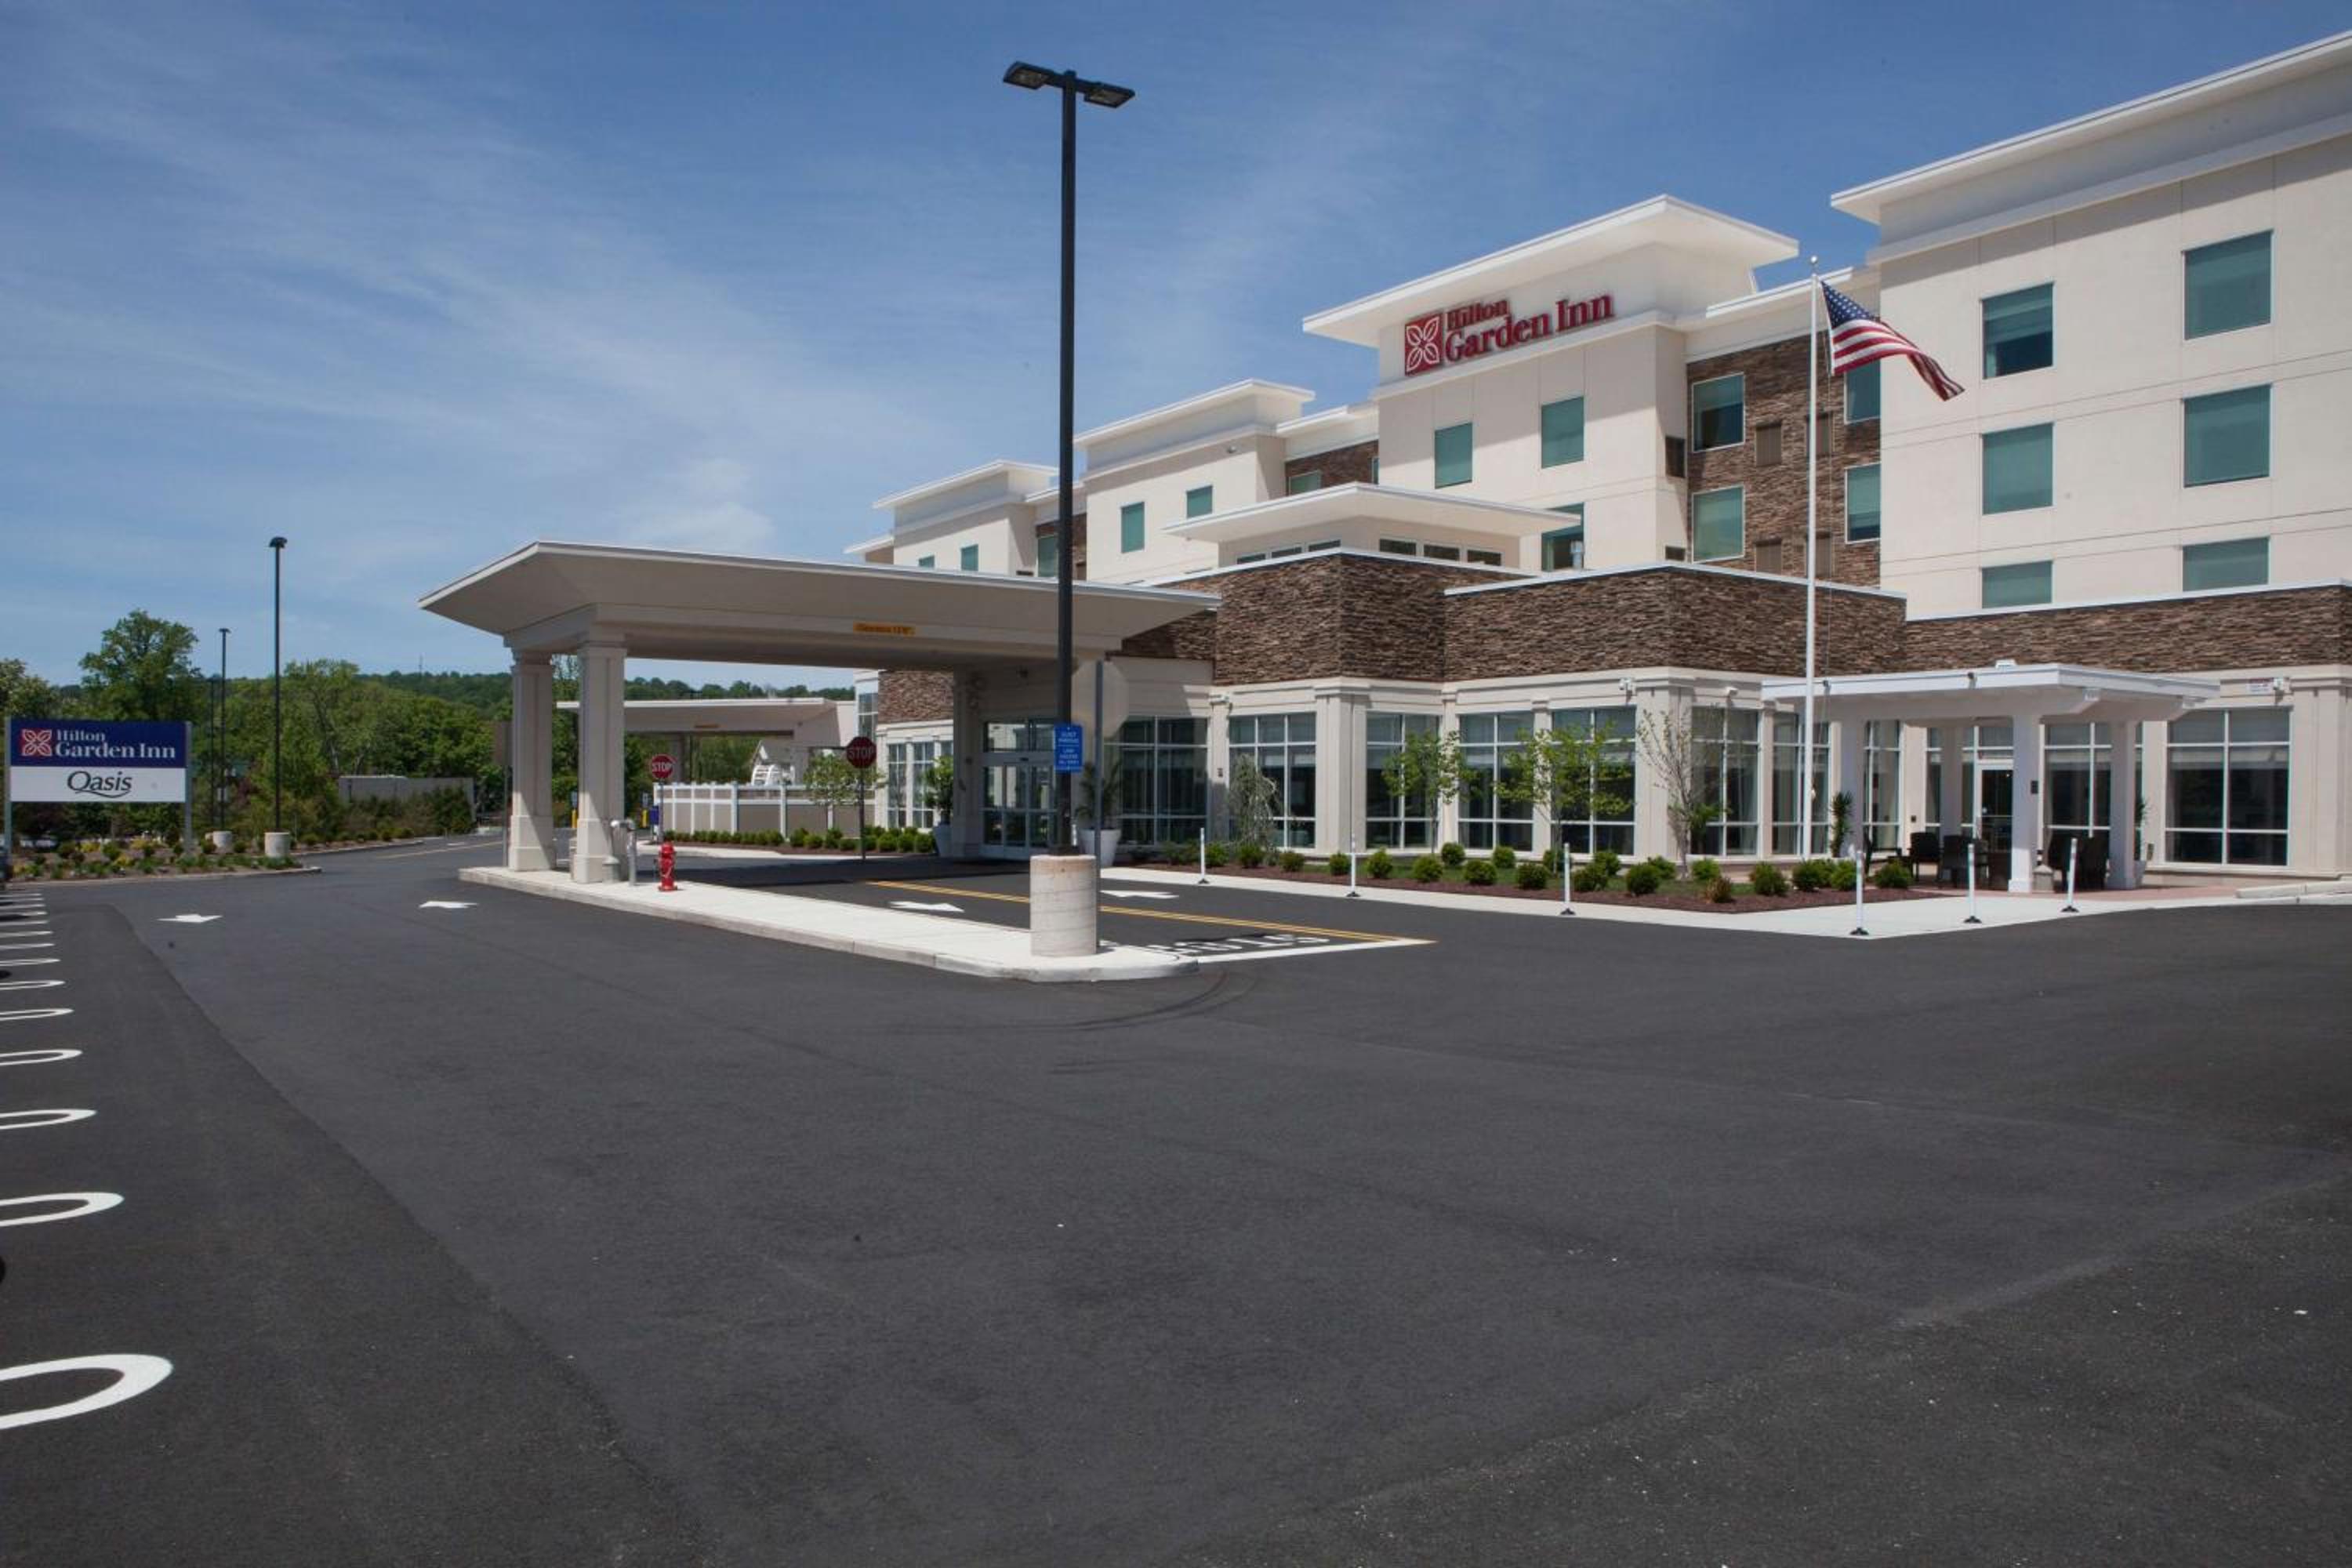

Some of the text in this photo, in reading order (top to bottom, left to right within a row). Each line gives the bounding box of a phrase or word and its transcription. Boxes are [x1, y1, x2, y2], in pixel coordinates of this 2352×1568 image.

[1446, 299, 1510, 330] Hilton
[1445, 293, 1614, 362] Garden Inn
[56, 729, 106, 742] Hilton
[56, 742, 176, 758] Garden Inn
[848, 746, 874, 760] STOP
[652, 761, 673, 772] STOP
[67, 771, 132, 798] Oasis
